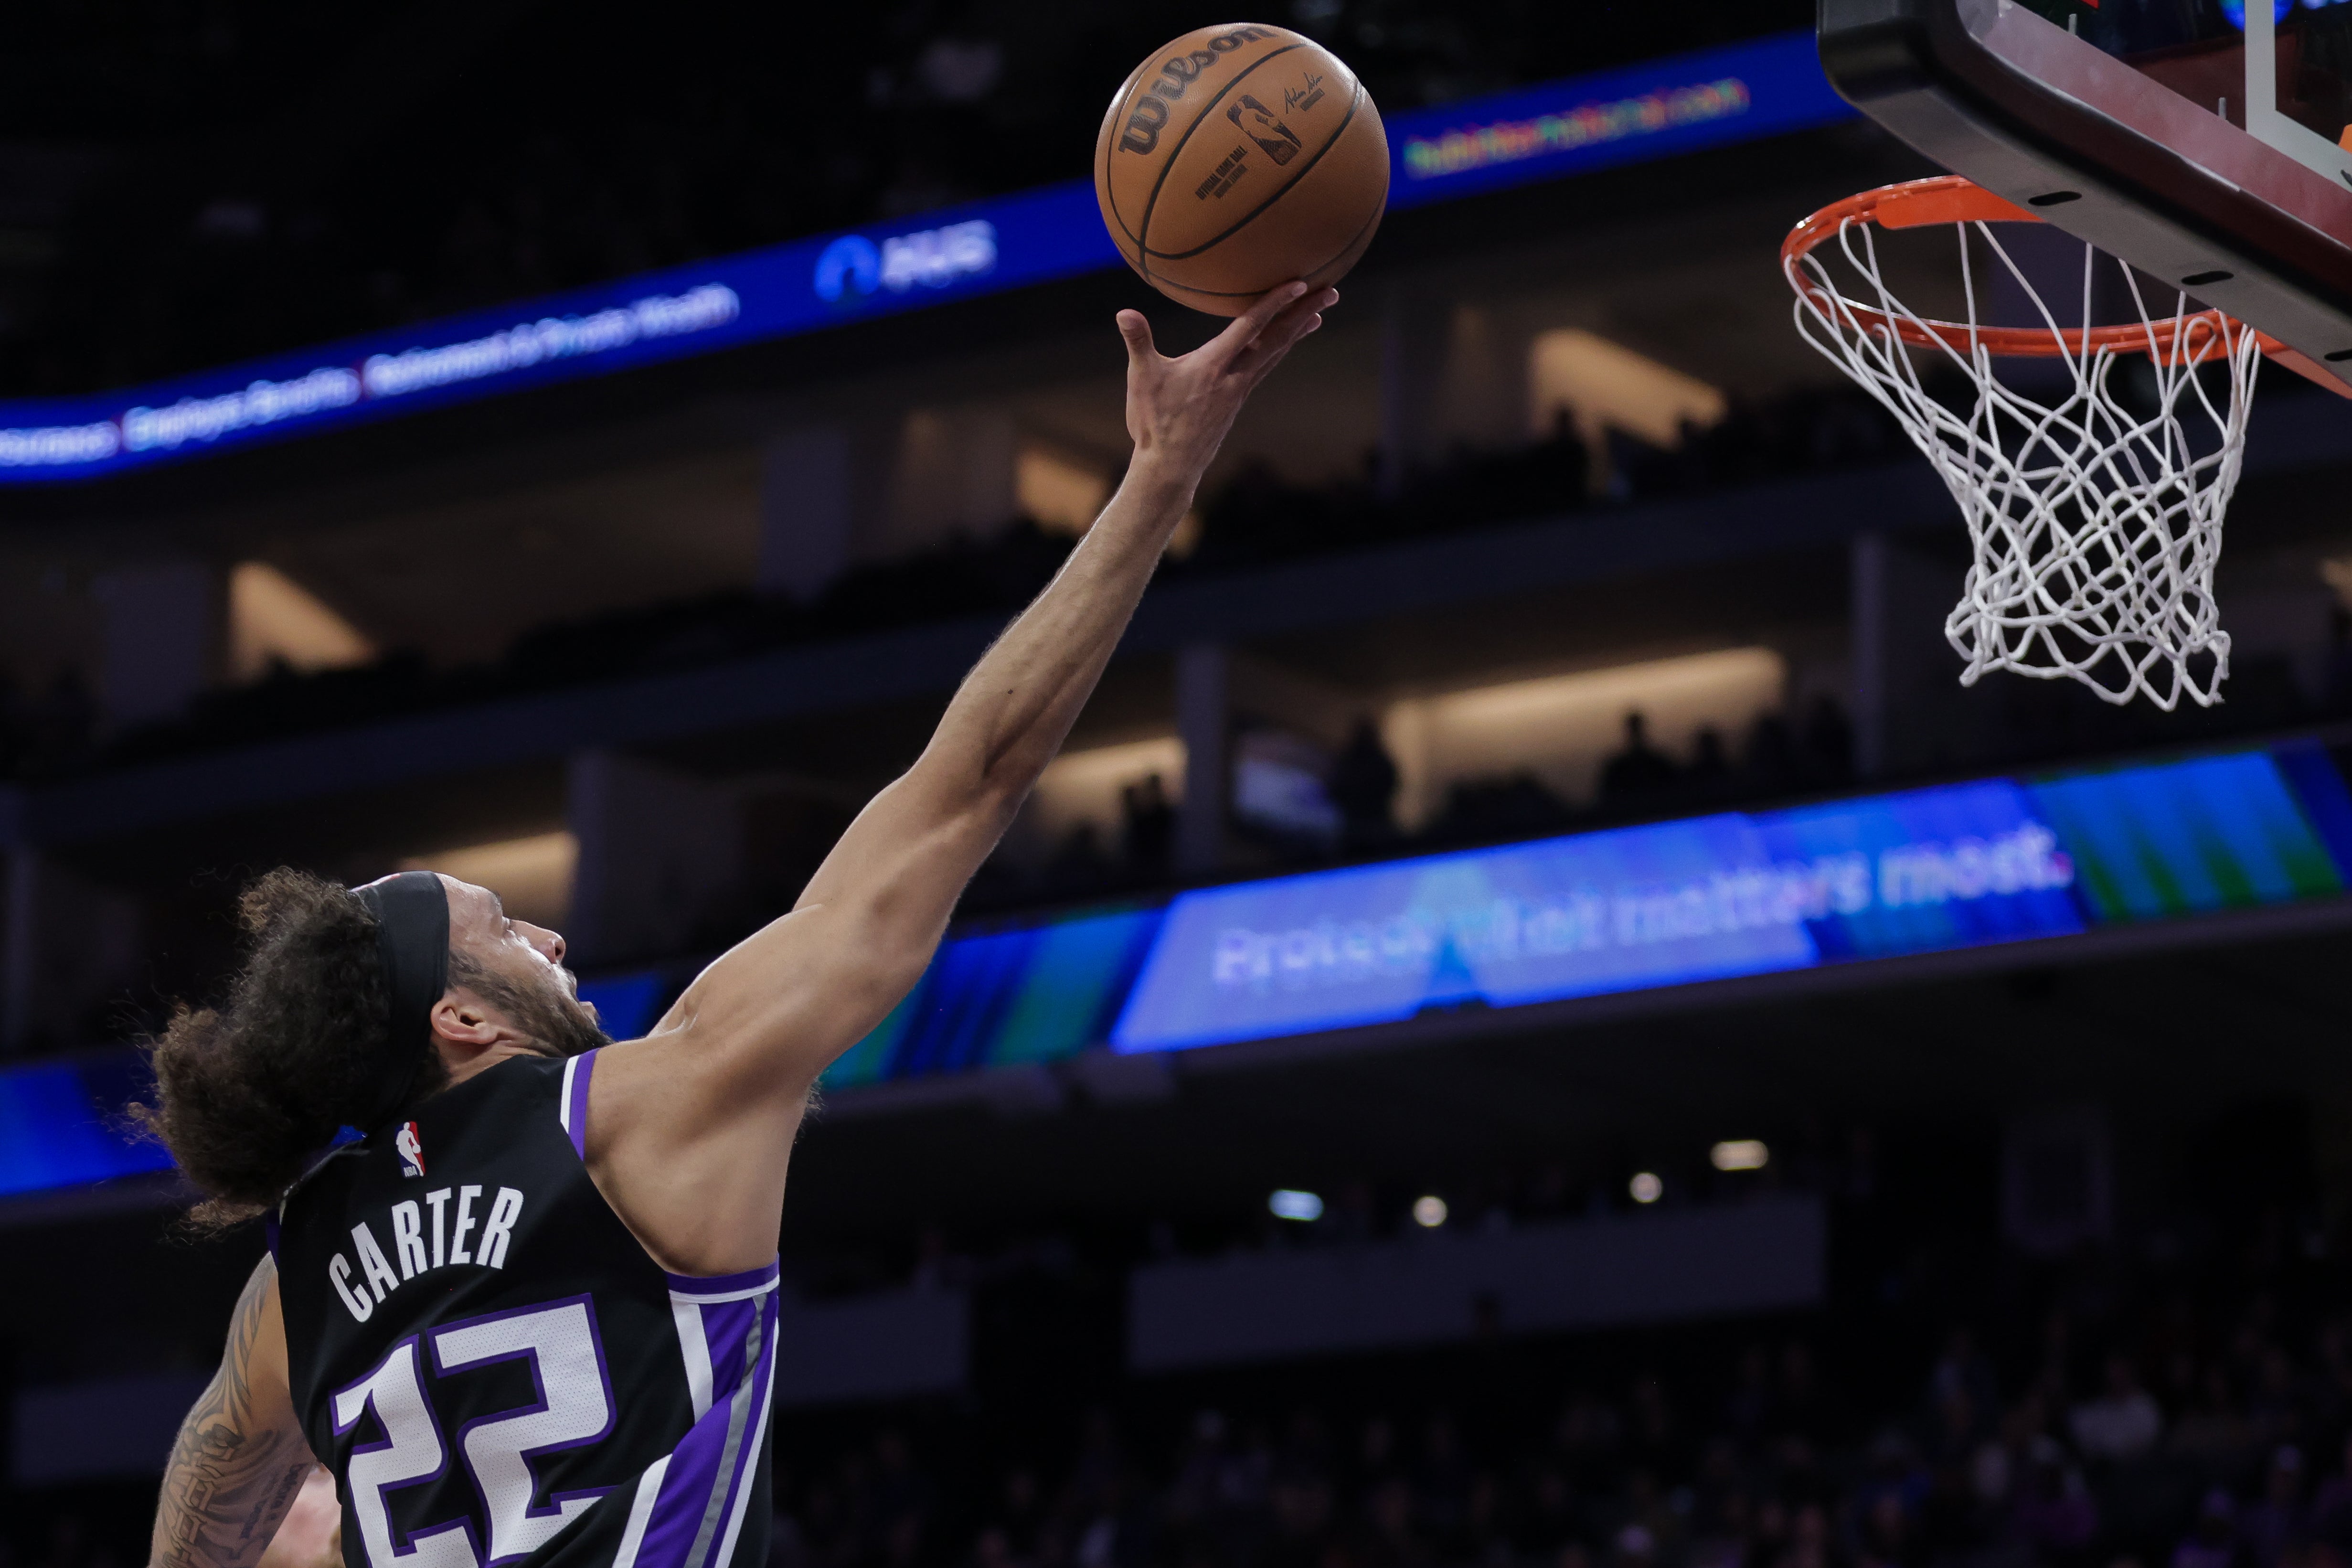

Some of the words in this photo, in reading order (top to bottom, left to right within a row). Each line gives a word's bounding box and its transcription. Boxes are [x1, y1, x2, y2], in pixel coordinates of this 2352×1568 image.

[1118, 27, 1278, 155] Wilson
[1229, 145, 1248, 162] BALL
[403, 1165, 417, 1177] NBA
[329, 1184, 523, 1323] CARTER
[330, 1292, 619, 1568] 22
